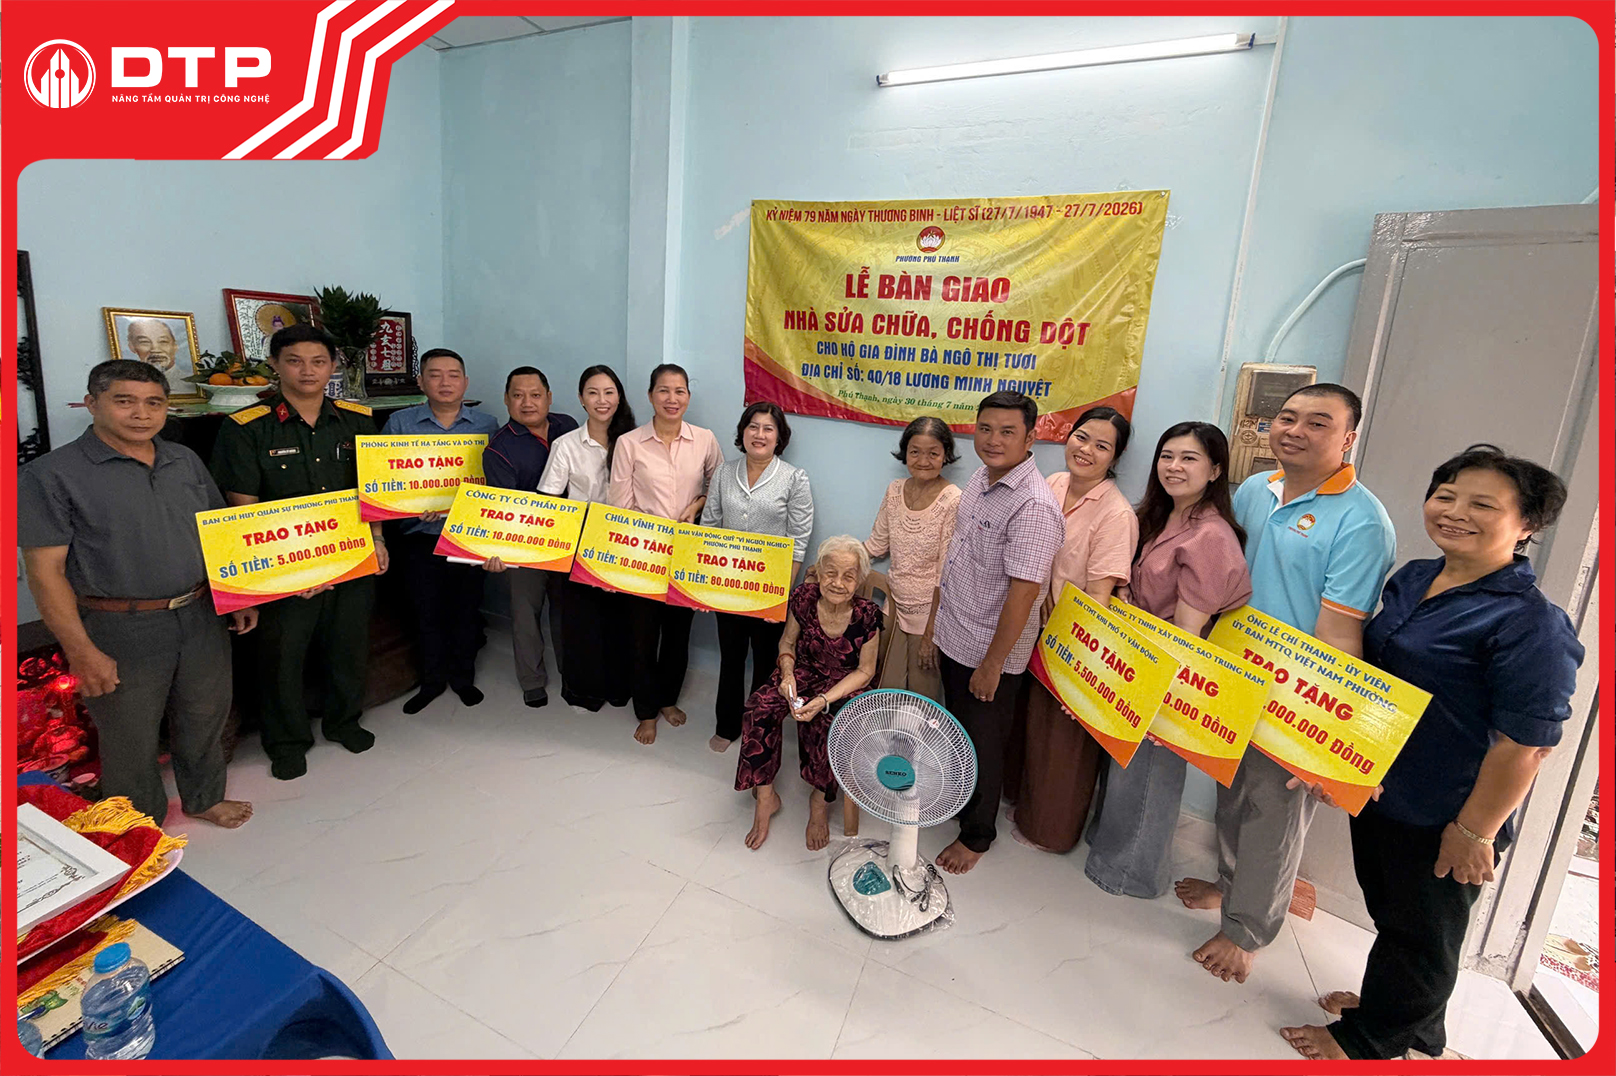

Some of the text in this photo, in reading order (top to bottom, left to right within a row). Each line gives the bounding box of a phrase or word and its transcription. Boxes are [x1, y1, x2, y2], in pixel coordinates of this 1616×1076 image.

[766, 206, 778, 221] KỶ
[779, 208, 802, 222] NIỆM
[804, 210, 816, 222] 79
[818, 208, 838, 223] NĂM
[840, 208, 866, 223] NGÀY
[868, 208, 906, 222] THƯƠNG
[909, 208, 934, 222] BINH
[944, 206, 966, 224] LIỆT
[968, 205, 980, 221] SĨ
[923, 255, 936, 263] PHÚ
[938, 255, 960, 264] THẠNH
[845, 266, 1010, 303] LỄ BÀN GIAO
[784, 306, 1091, 350] NHÀ SỬA CHỮA, CHỐNG DỘT
[817, 341, 1036, 370] CHO HỘ GIA ĐÌNH BÀ NGÔ THỊ TƯƠI
[802, 362, 1052, 399] ĐỊA CHỈ SỐ: 40/18 LƯƠNG MINH NGUYỆT
[838, 390, 854, 399] Phú
[882, 396, 903, 406] ngày
[918, 398, 943, 408] tháng
[953, 402, 974, 411] năm
[388, 456, 464, 470] TRAO TẶNG
[365, 478, 460, 493] SỐ TIỀN: 10.000.000
[466, 490, 496, 501] CÔNG
[499, 495, 512, 503] TY
[513, 496, 528, 505] CỔ
[530, 500, 557, 510] PHẦN
[202, 518, 220, 526] BAN
[223, 512, 237, 522] CHỈ
[239, 510, 254, 520] HUY
[257, 507, 280, 517] QUÂN
[281, 506, 292, 514] SỰ
[293, 502, 323, 510] PHƯỜNG
[324, 498, 338, 506] PHÚ
[480, 508, 555, 527] TRAO TẶNG
[605, 512, 655, 530] CHÙA VĨNH
[243, 518, 338, 546] TRAO TẶNG
[449, 522, 571, 551] SỐ TIỀN: 10.000.000 Đồng
[608, 531, 674, 556] TRAO TẶNG
[703, 540, 728, 549] PHƯỜNG
[704, 532, 722, 540] ĐỘNG
[746, 538, 765, 546] NGƯỜI
[219, 537, 366, 579] SỐ TIỀN: 5.000.000 Đồng
[582, 547, 667, 576] SỐ TIỀN: 10.000.000
[697, 553, 766, 573] TRAO TẶNG
[674, 568, 785, 597] SỐ TIỀN: 80.000.000 Đồng
[1073, 596, 1083, 607] BAN
[1096, 613, 1108, 625] KHU
[1107, 622, 1120, 634] PHỐ
[1120, 632, 1128, 640] 47
[1140, 646, 1159, 664] ĐỘNG
[1108, 603, 1265, 686] CÔNG TY TNHH XÂY DỰNG SAO TRUNG NAM
[1070, 622, 1136, 683] TRAO TẶNG
[1232, 619, 1398, 713] ỦY BAN MTTQ VIỆT NAM PHƯỜNG
[1246, 613, 1392, 693] ÔNG LÊ CHÍ THANH ỦY VIÊN
[1045, 633, 1142, 729] SỐ TIỀN: 5.500.000 Đồng
[1177, 665, 1219, 697] ẶNG
[1293, 677, 1354, 721] TẶNG
[1201, 713, 1237, 745] Đồng
[1263, 699, 1375, 775] .000.000 Đồng
